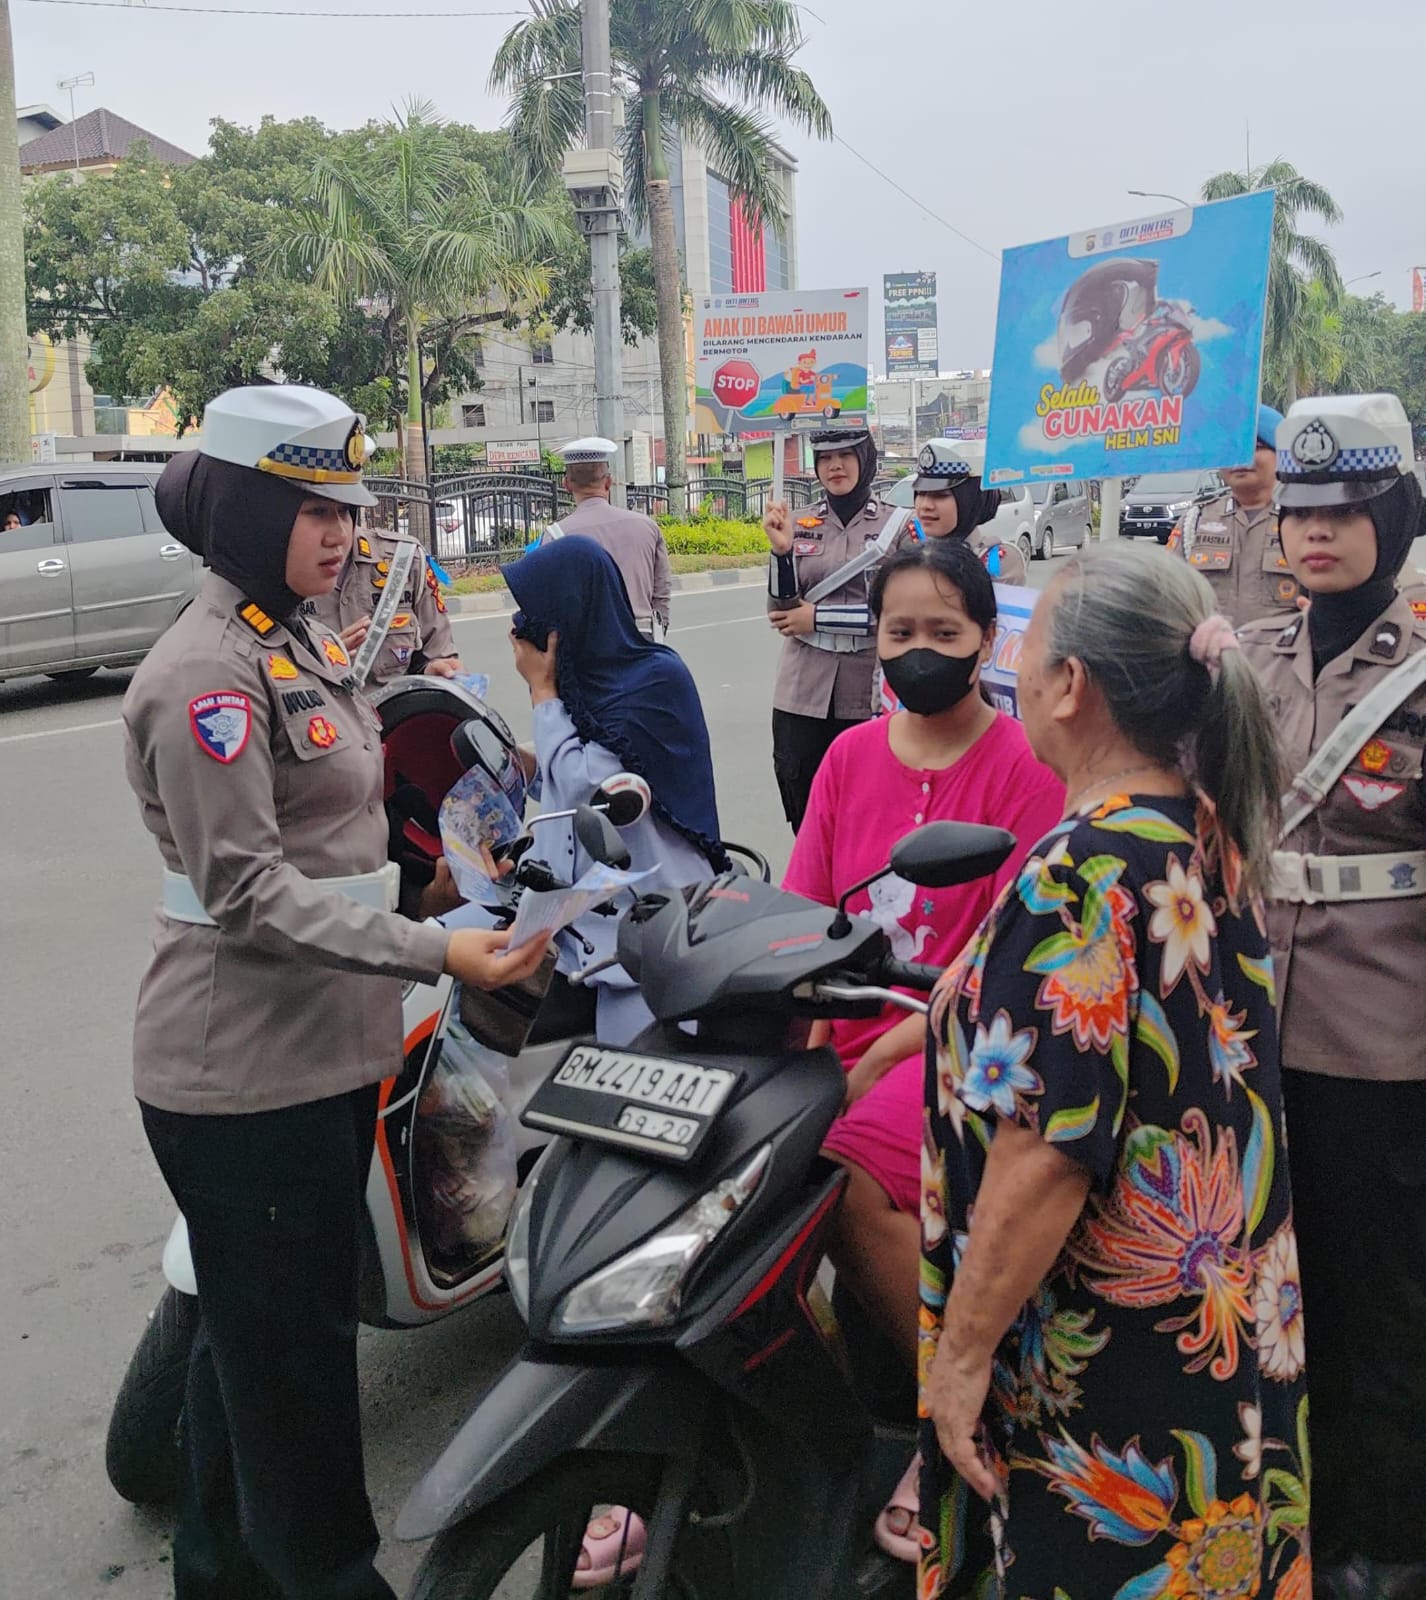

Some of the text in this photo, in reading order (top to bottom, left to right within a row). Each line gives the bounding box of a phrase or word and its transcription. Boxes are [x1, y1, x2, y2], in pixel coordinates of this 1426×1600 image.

[704, 317, 740, 338] ANAK
[806, 311, 848, 334] UMUR
[703, 333, 863, 347] DILARANG MENGENDARAI KENDARAAN
[703, 347, 748, 356] BERMOTOR
[717, 374, 755, 391] STOP
[1036, 380, 1100, 416] Selalu
[1044, 396, 1183, 438] GUNAKAN
[1105, 428, 1180, 450] HELM SNI
[300, 600, 317, 616] BAR
